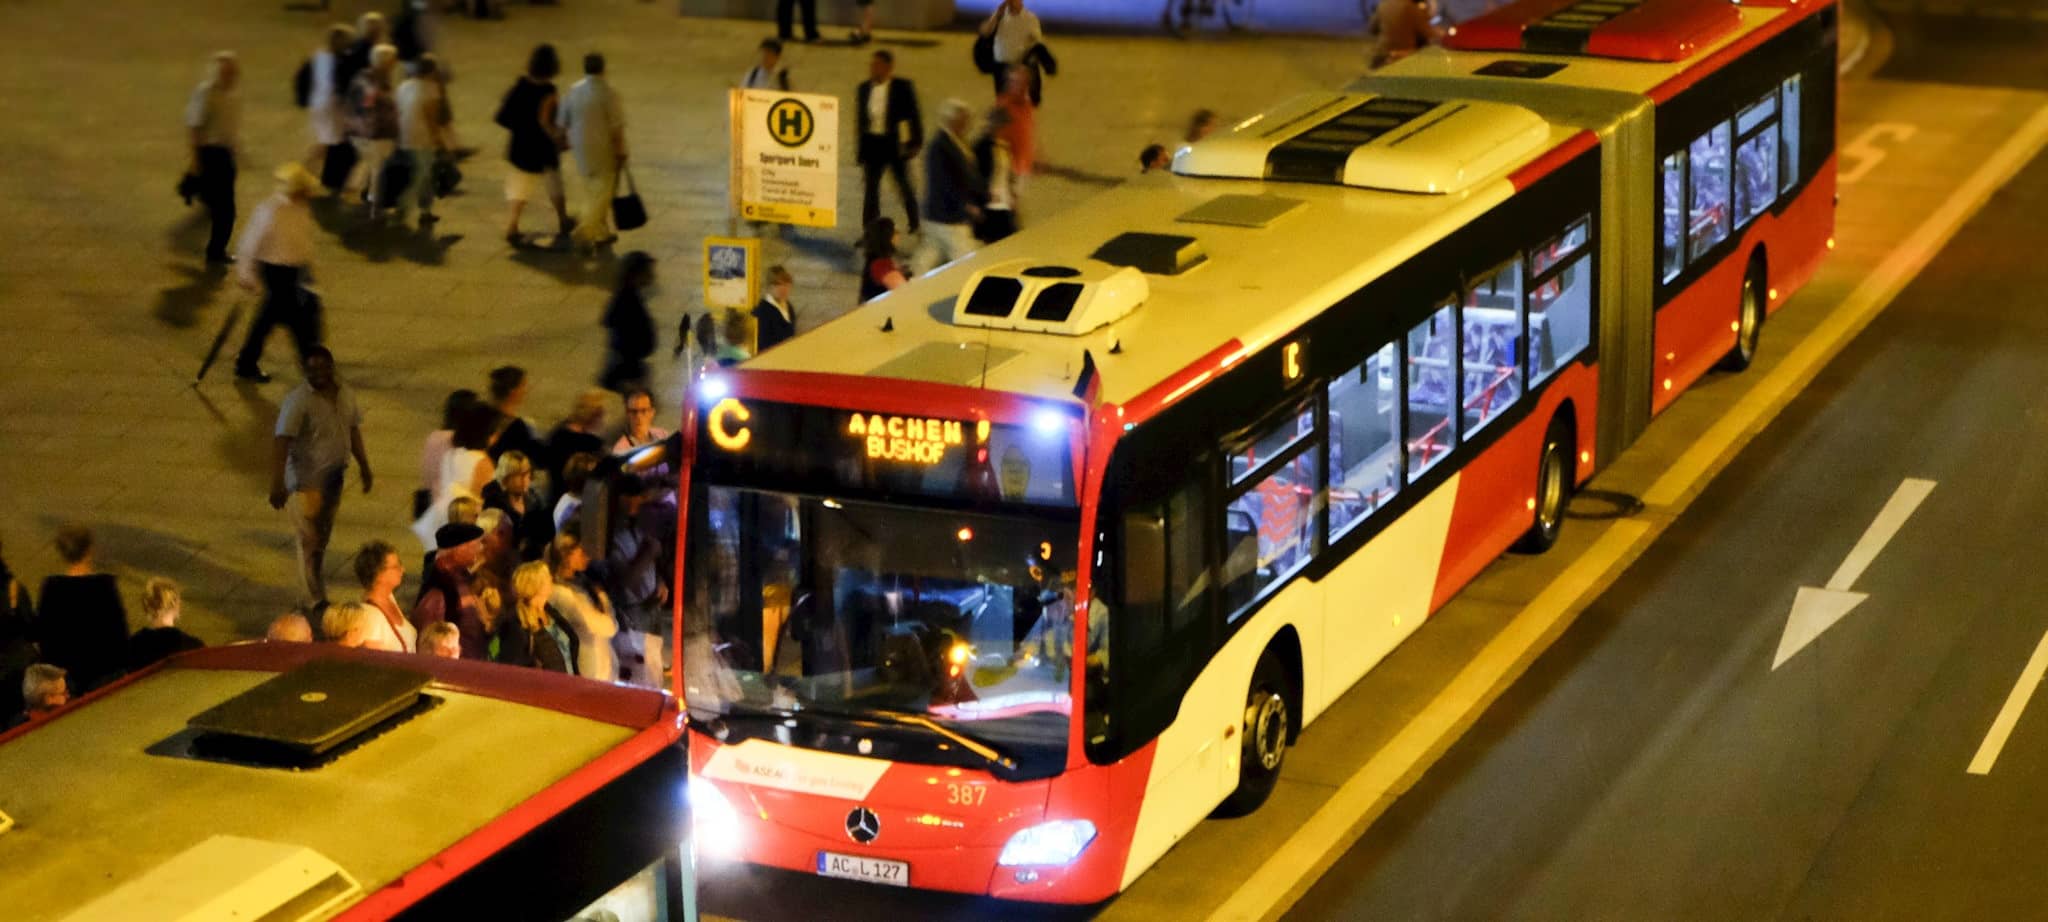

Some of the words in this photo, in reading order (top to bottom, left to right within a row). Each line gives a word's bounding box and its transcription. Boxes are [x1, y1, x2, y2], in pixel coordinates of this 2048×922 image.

[778, 108, 803, 137] H
[708, 397, 751, 451] C
[848, 412, 962, 444] AACHEN
[866, 435, 945, 464] BUSHOF
[947, 783, 987, 807] 387
[832, 856, 850, 873] AC
[860, 862, 870, 876] L
[874, 864, 901, 880] 127
